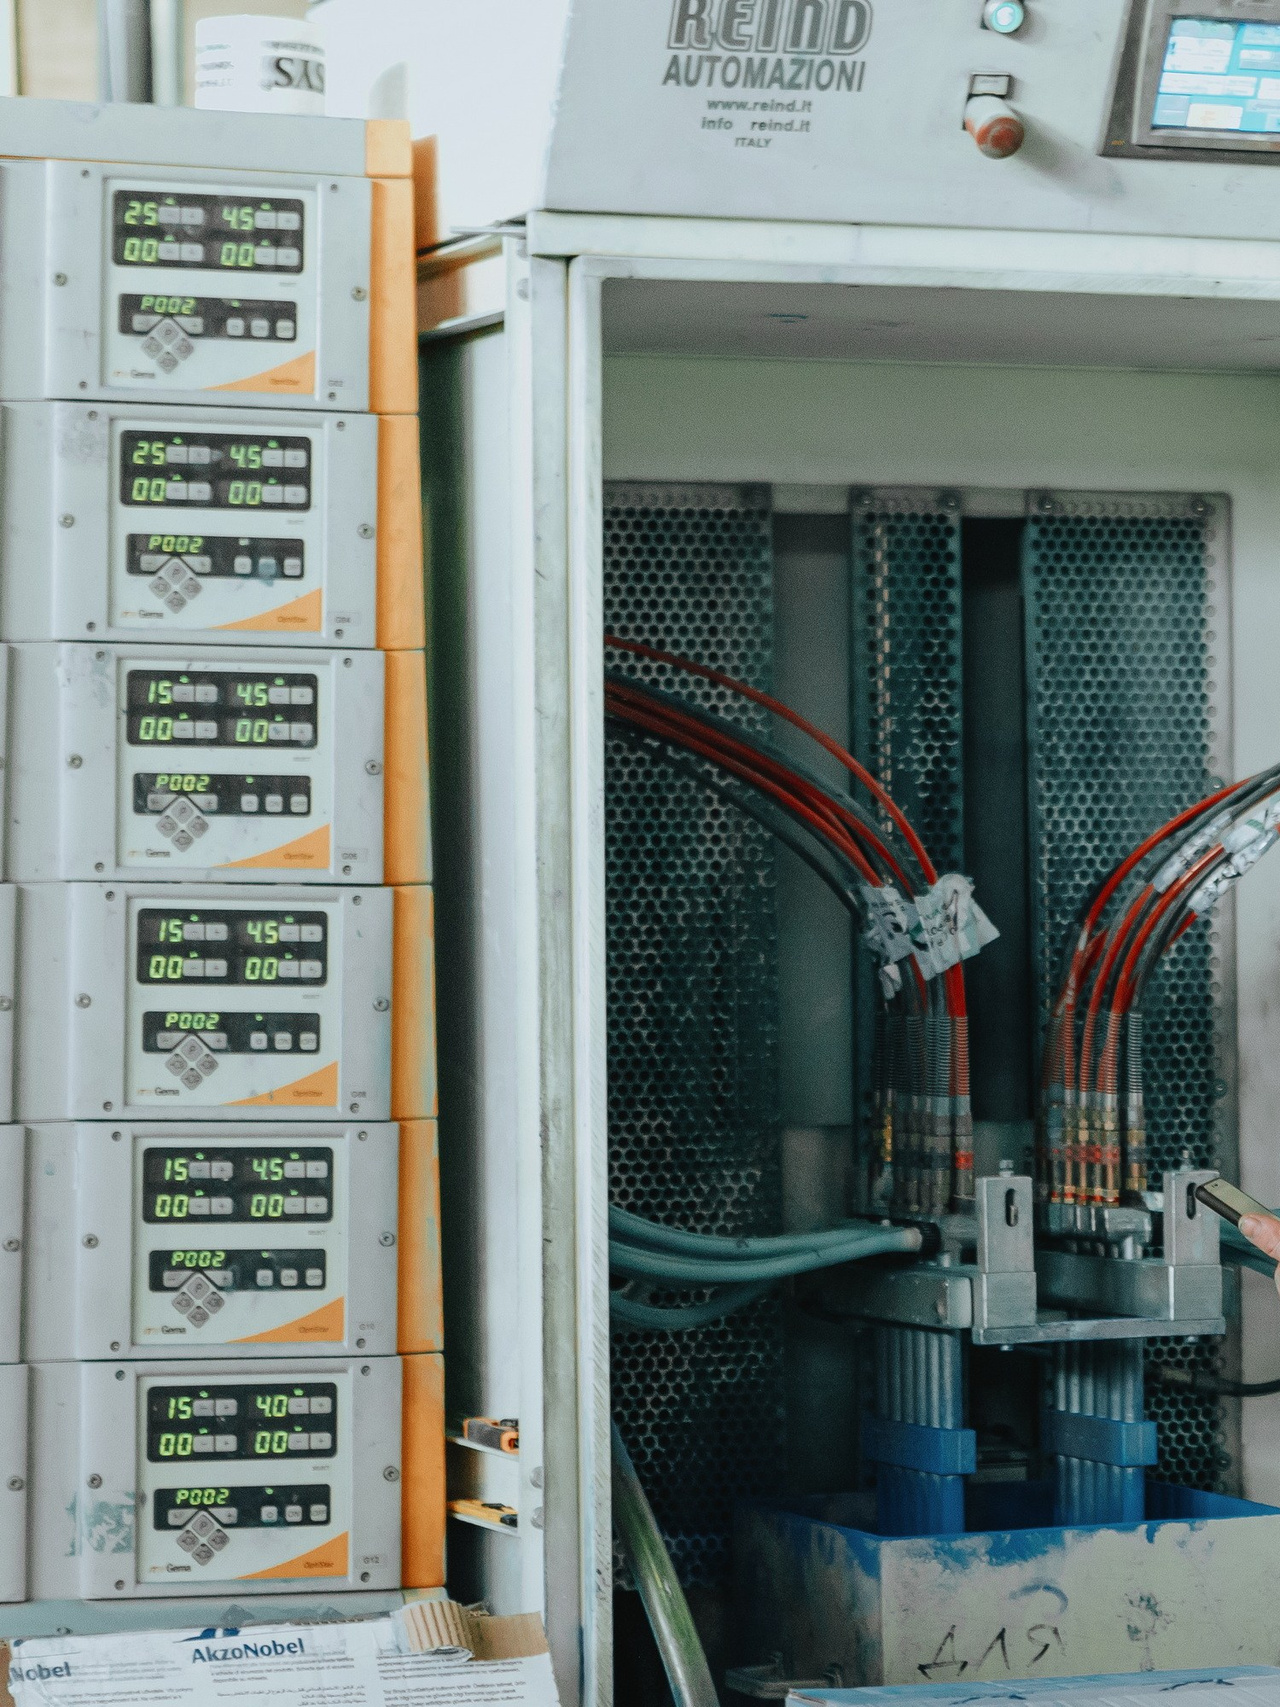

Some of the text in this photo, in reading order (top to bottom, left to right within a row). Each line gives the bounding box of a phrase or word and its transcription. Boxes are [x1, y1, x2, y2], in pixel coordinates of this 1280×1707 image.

[662, 55, 866, 92] AUTOMAZIONI
[707, 99, 813, 113] www.reind.it
[701, 117, 811, 132] info reind.it
[734, 137, 773, 148] ITALY
[124, 200, 158, 227] 25
[123, 237, 159, 263] 00
[220, 242, 255, 267] 00
[141, 295, 196, 315] P002
[132, 440, 166, 466] 25
[132, 477, 166, 502] 00
[228, 481, 262, 506] 00
[149, 535, 203, 554] P002
[148, 680, 173, 705] 15
[139, 716, 173, 741] 00
[235, 718, 269, 743] 00
[155, 774, 210, 792] P002
[158, 919, 183, 943] 15
[150, 955, 183, 979] 00
[245, 957, 279, 981] 00
[165, 1013, 220, 1030] P002
[164, 1158, 187, 1181] 15
[155, 1194, 189, 1218] 00
[250, 1194, 284, 1218] 00
[172, 1250, 226, 1267] P002
[167, 1396, 192, 1420] 15
[159, 1433, 192, 1457] 00
[254, 1431, 287, 1454] 00
[176, 1489, 230, 1506] P002
[192, 1637, 305, 1664] AkzoNobel
